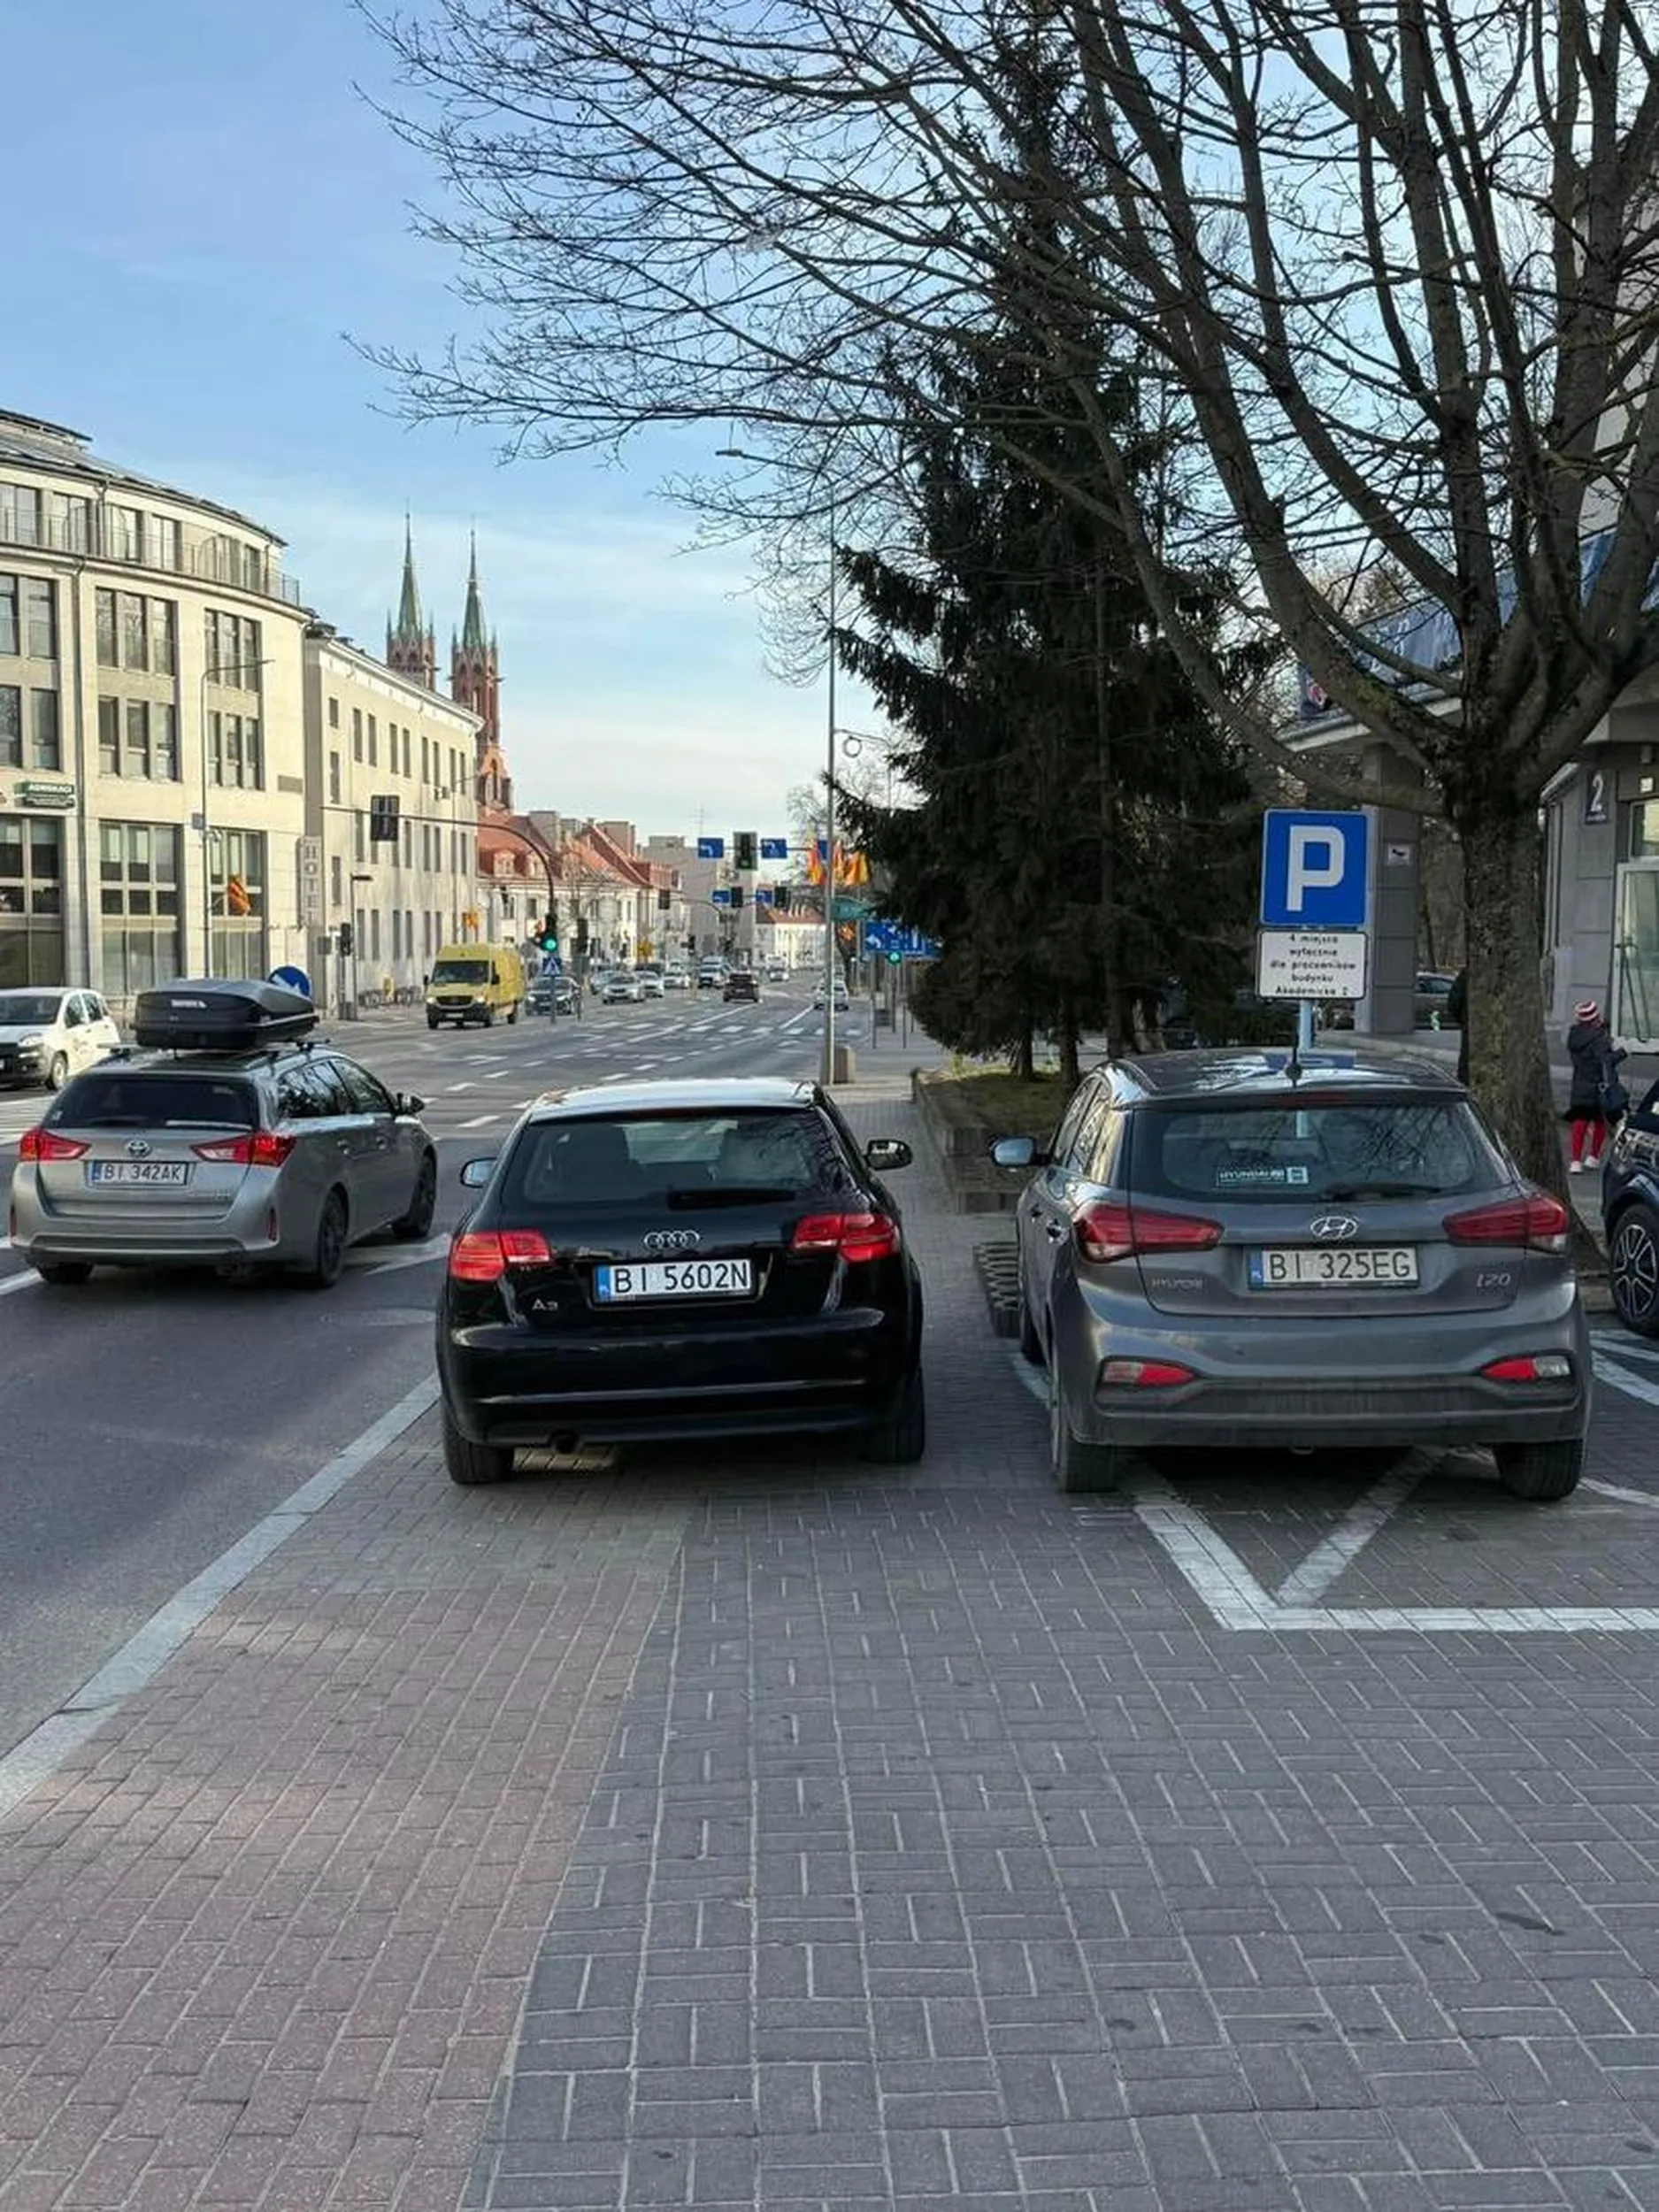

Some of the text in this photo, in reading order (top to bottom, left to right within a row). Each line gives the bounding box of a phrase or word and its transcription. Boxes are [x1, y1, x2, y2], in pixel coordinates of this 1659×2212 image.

[1591, 774, 1603, 811] 2
[1286, 825, 1344, 911] P
[104, 1162, 122, 1179] BI
[132, 1164, 180, 1180] 342AK
[614, 1268, 647, 1294] BI
[664, 1262, 749, 1291] 5602N
[1269, 1250, 1411, 1280] BI 325EG
[532, 1298, 558, 1311] A3
